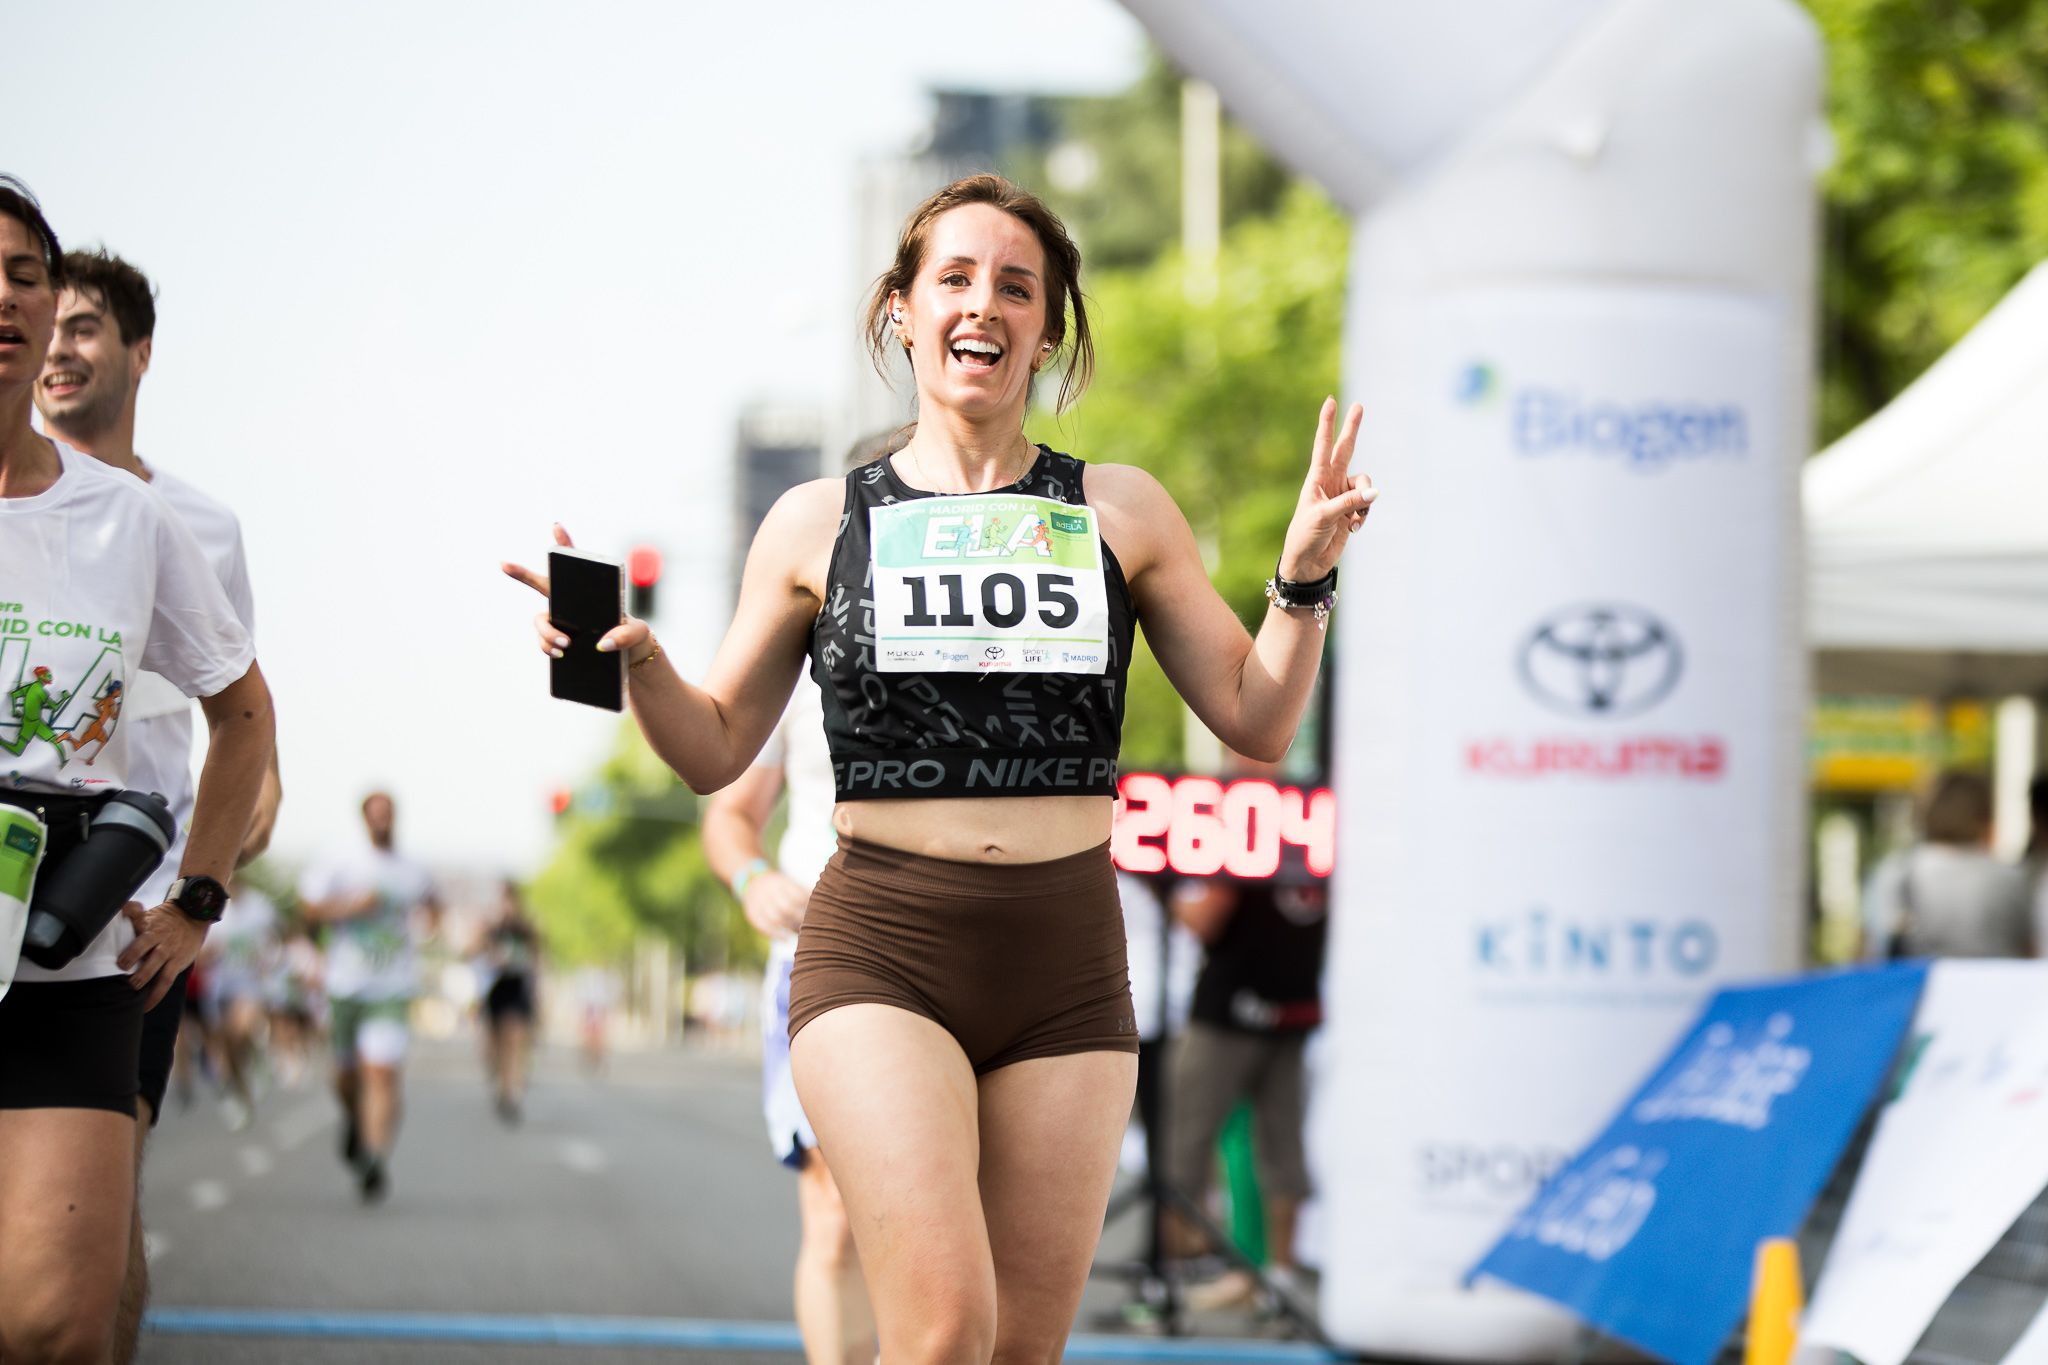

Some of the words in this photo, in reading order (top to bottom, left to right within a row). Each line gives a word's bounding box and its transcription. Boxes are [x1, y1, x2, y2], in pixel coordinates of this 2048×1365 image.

[1512, 389, 1748, 473] Biogen
[929, 503, 985, 516] MADRID
[988, 502, 1018, 512] CON
[1021, 503, 1038, 512] LA
[920, 513, 1052, 558] ELA
[902, 572, 1079, 629] 1105
[0, 618, 29, 635] ID
[37, 620, 92, 639] CON
[98, 627, 122, 648] LA
[942, 652, 969, 662] Biogen
[1070, 654, 1098, 664] MADRID
[847, 759, 946, 790] PRO
[965, 757, 1083, 787] NIKE
